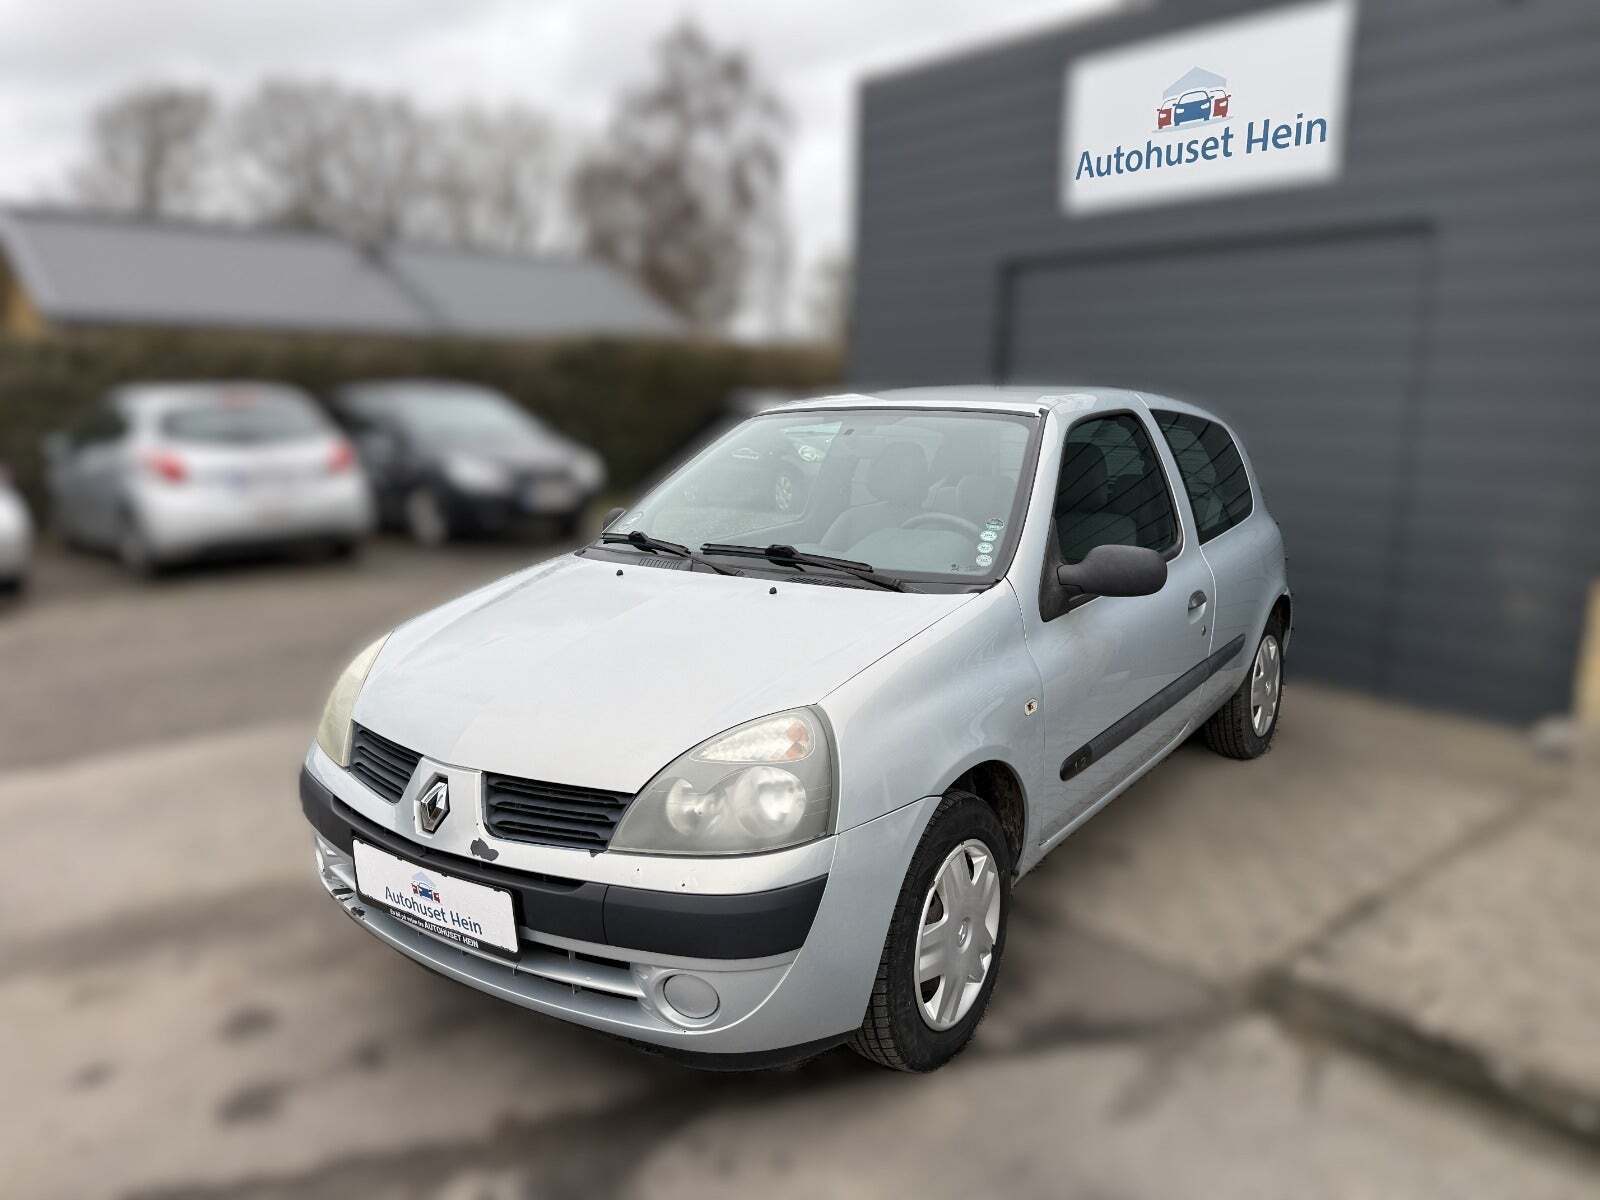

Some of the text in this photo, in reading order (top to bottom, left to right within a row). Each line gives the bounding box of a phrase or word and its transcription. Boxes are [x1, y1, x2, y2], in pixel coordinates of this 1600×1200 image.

[1075, 112, 1328, 180] Autohuset Hein
[385, 886, 447, 923] Autohuset
[450, 910, 482, 935] Hein
[424, 921, 479, 948] AUTOHUSET HEIN
